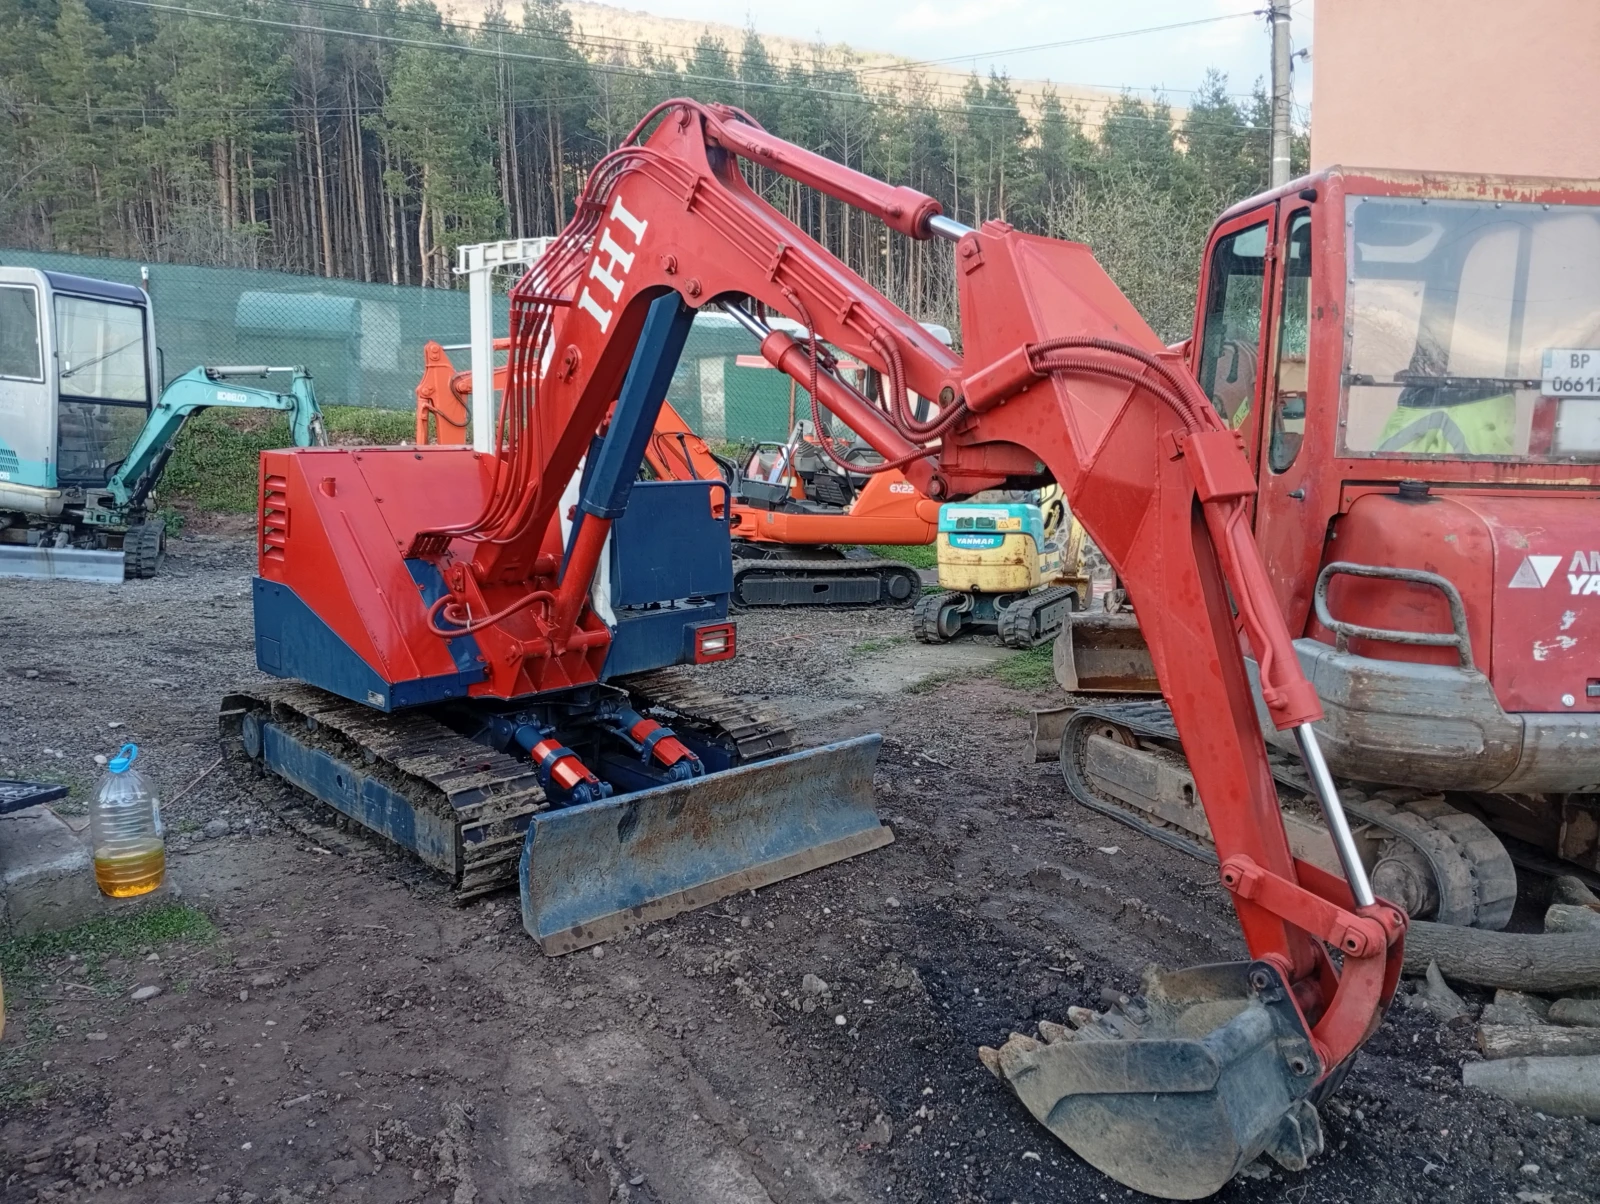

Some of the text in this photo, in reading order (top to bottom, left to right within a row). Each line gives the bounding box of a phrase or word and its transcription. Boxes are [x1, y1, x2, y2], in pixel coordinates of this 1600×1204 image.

[578, 195, 648, 334] IHI
[1570, 353, 1590, 369] BP
[889, 483, 915, 494] EX22
[956, 537, 994, 545] YANMAR
